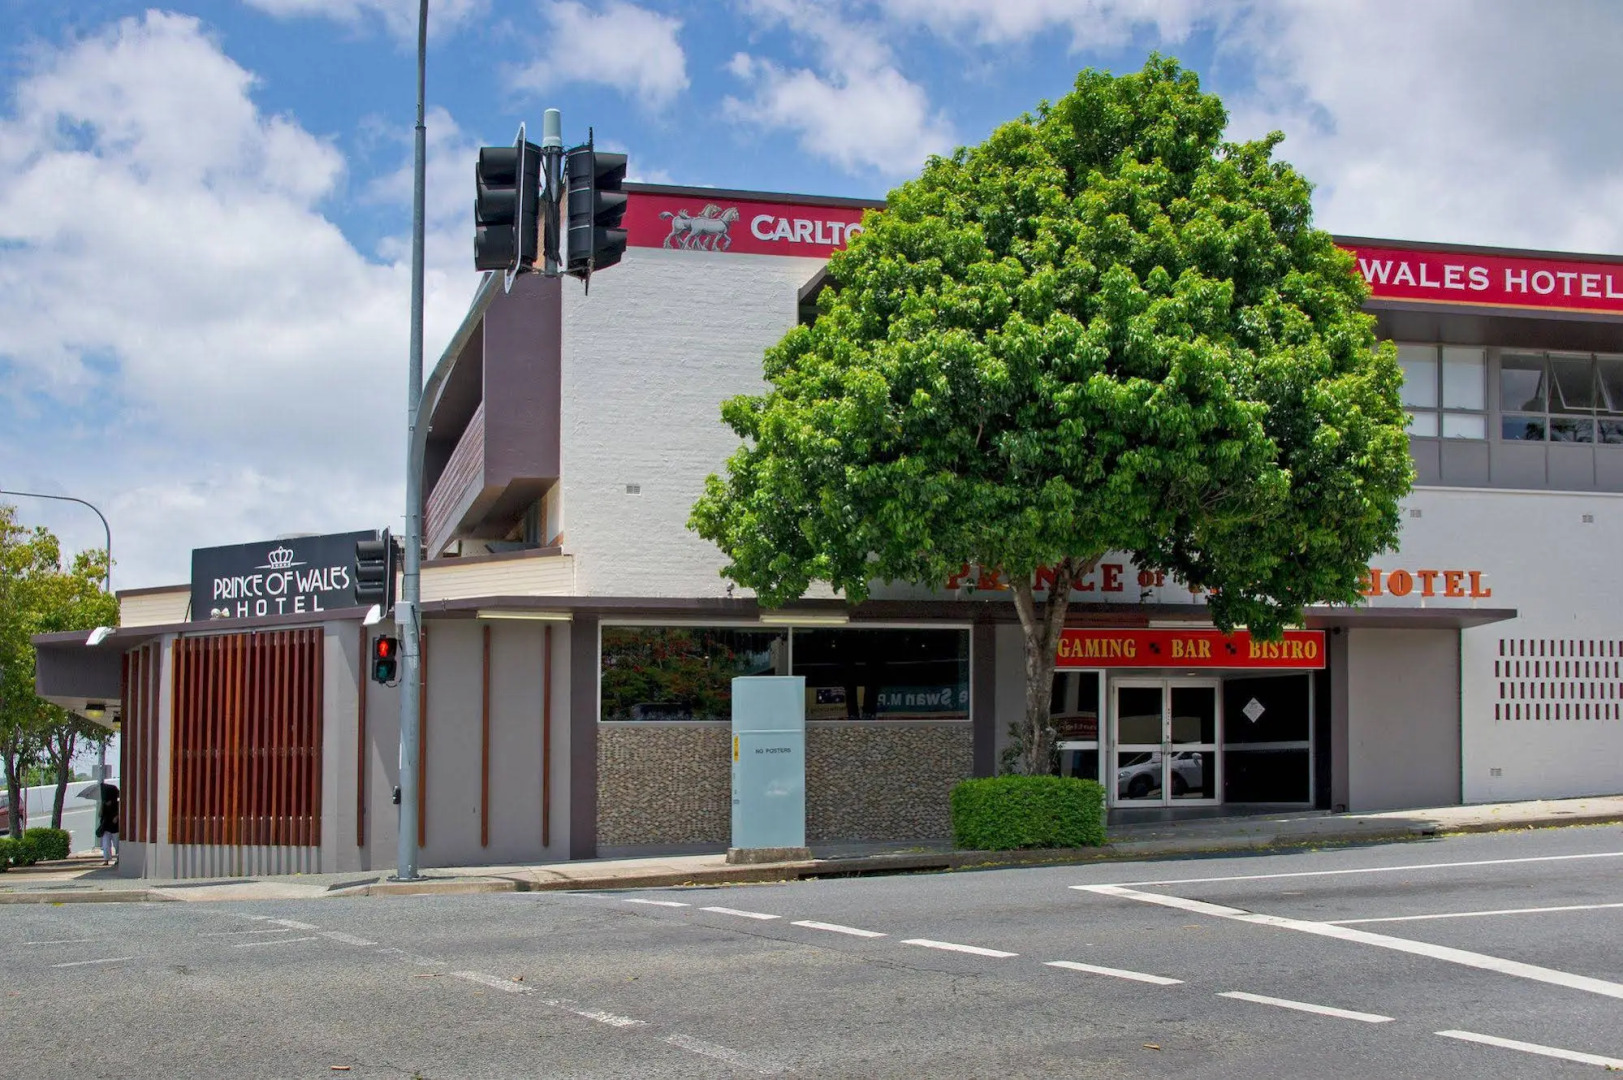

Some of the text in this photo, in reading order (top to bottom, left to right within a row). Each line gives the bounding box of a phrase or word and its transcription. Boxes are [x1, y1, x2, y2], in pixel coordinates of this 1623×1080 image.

[1358, 258, 1623, 299] WALES HOTEL
[213, 566, 350, 600] PRINCE OF WALES
[944, 562, 1124, 592] PRNE
[1137, 570, 1165, 587] OF
[1357, 568, 1492, 597] HOTEL
[236, 594, 325, 618] HOTEL
[1057, 638, 1318, 660] GAMING BAR BISTRO
